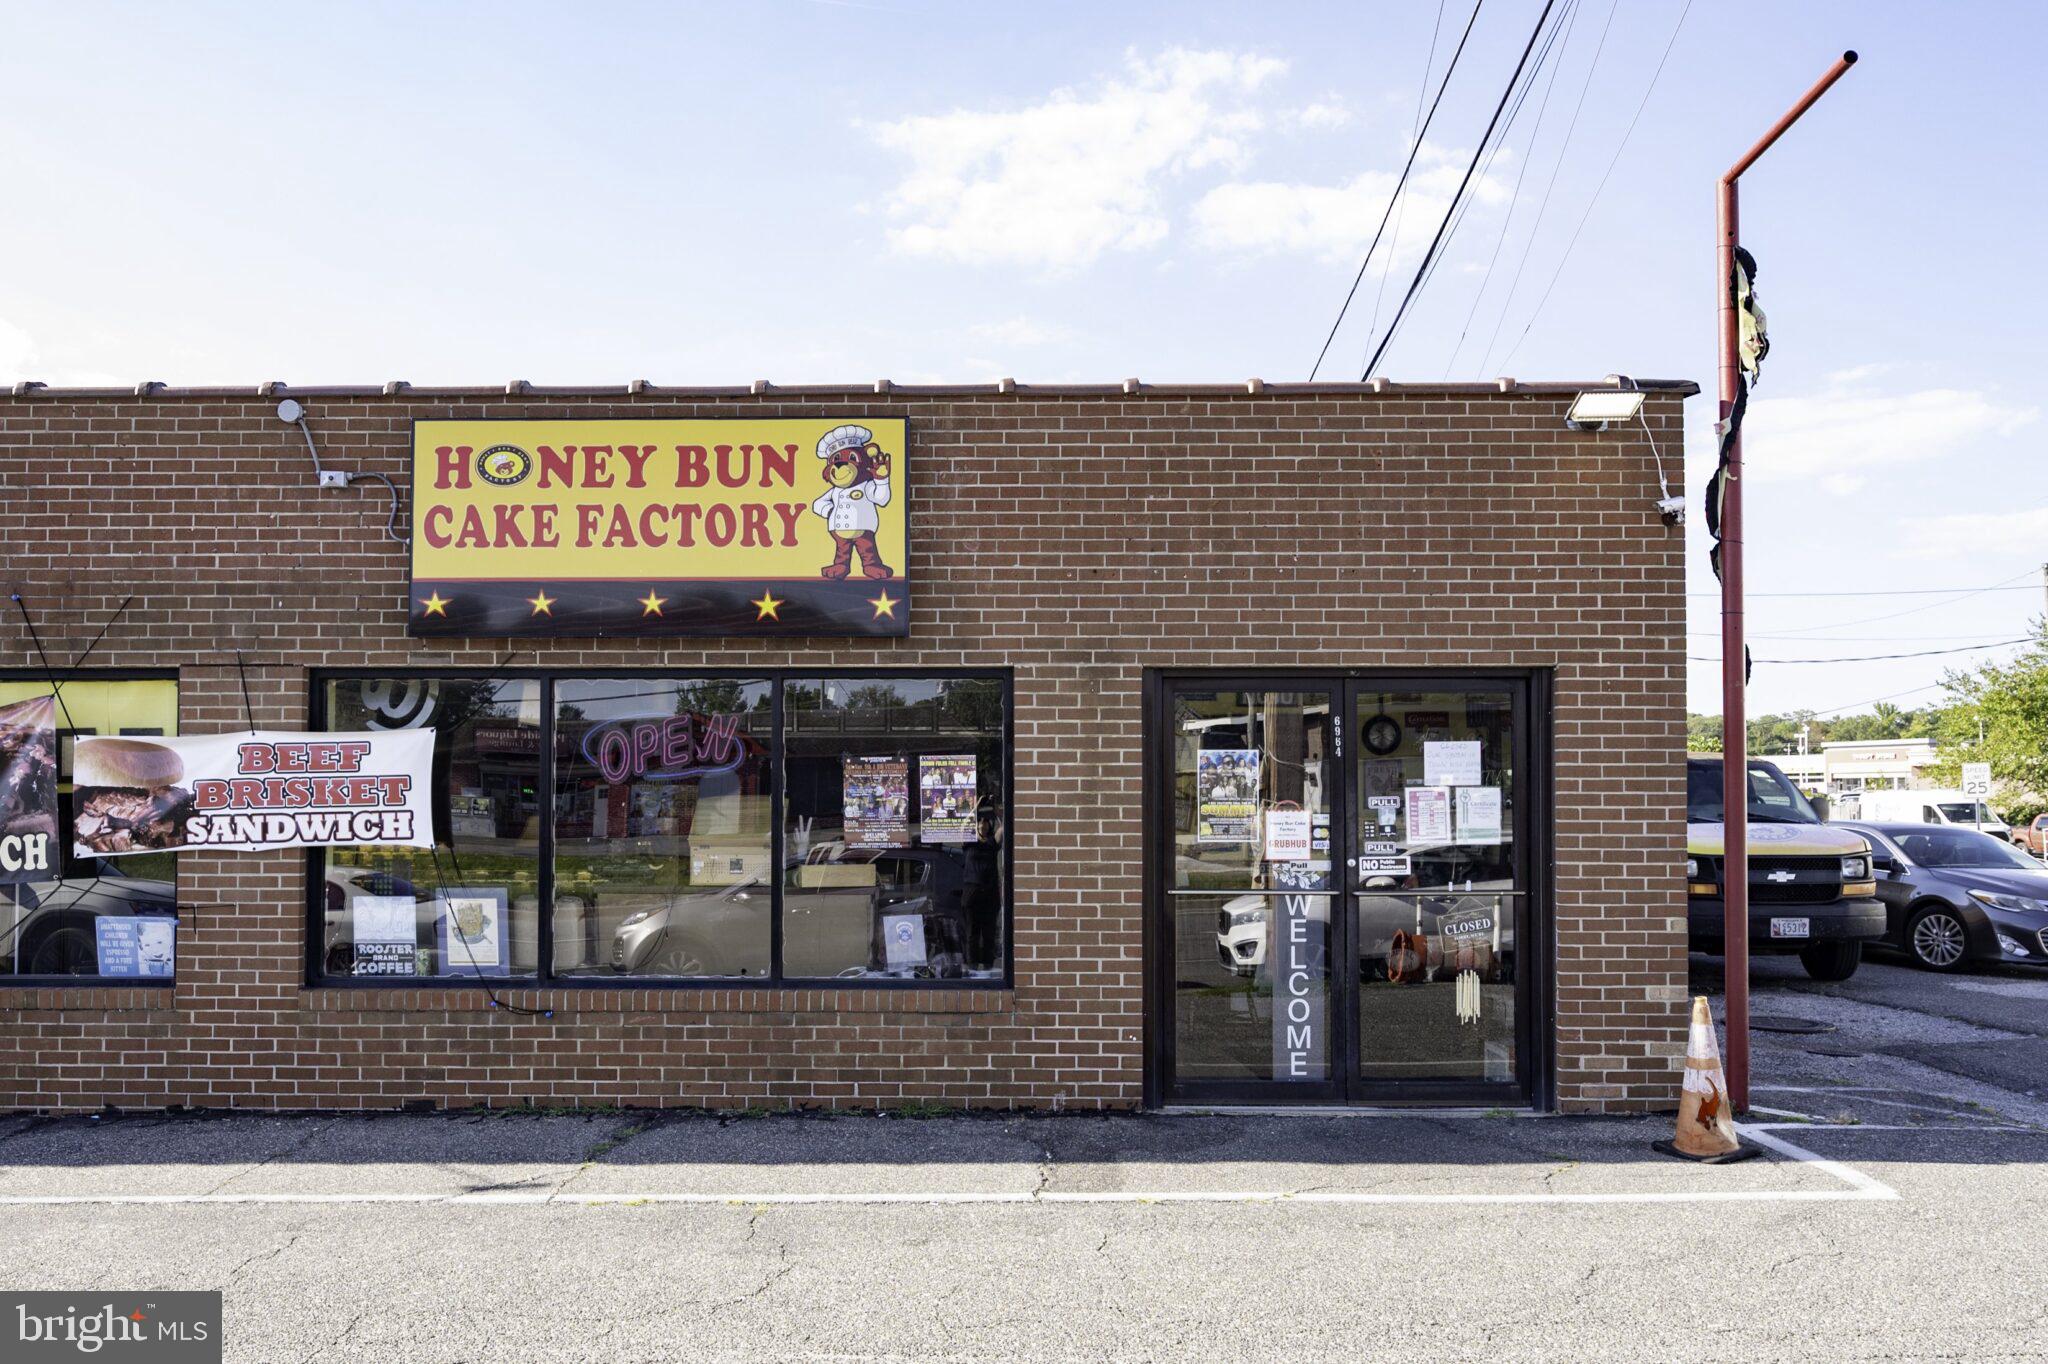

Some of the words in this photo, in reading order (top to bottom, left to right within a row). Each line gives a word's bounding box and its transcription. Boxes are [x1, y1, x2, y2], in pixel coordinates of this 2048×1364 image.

[674, 444, 800, 489] BUN
[423, 503, 560, 548] CAKE
[575, 502, 808, 548] FACTORY
[599, 713, 739, 784] OPEN
[1333, 716, 1341, 757] 6964
[238, 741, 371, 774] BEEF
[193, 775, 412, 811] BRISKET
[1967, 782, 1988, 794] 25
[186, 810, 415, 844] SANDWICH
[1362, 860, 1379, 870] NO
[1444, 918, 1491, 936] CLOSED
[357, 944, 414, 954] ROOSTER
[357, 961, 414, 974] COFFEE
[1285, 895, 1312, 1077] WELCOME
